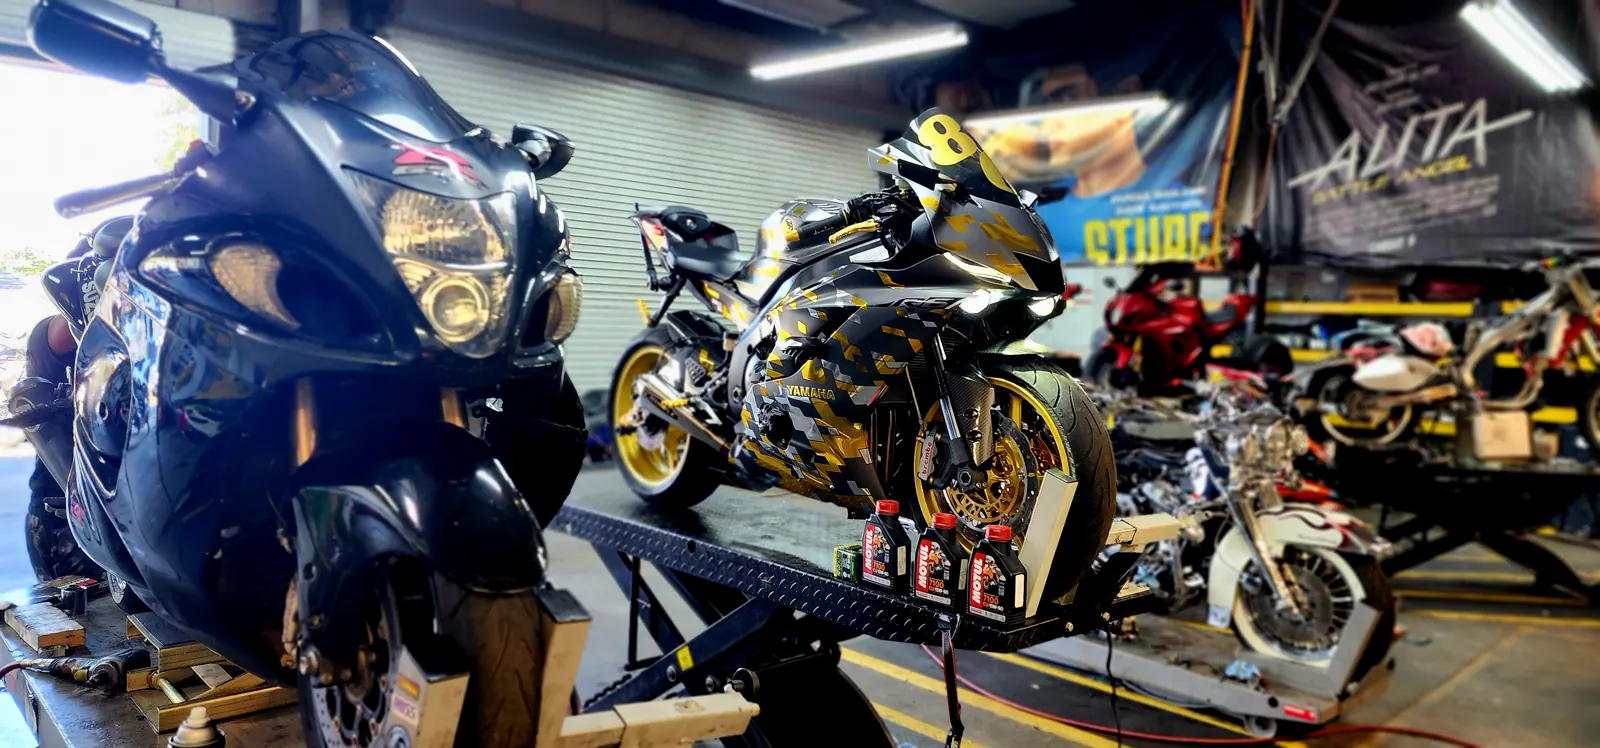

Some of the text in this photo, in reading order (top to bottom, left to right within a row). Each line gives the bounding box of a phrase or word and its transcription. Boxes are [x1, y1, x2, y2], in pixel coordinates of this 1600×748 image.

[1288, 98, 1534, 190] ALITA
[786, 385, 836, 400] YAMAHA
[922, 442, 932, 474] brembo
[865, 529, 873, 570] MOTUL
[918, 545, 929, 588] MOTUL
[929, 579, 944, 589] 7100
[972, 558, 983, 604] MOTUL
[983, 594, 999, 605] 7100
